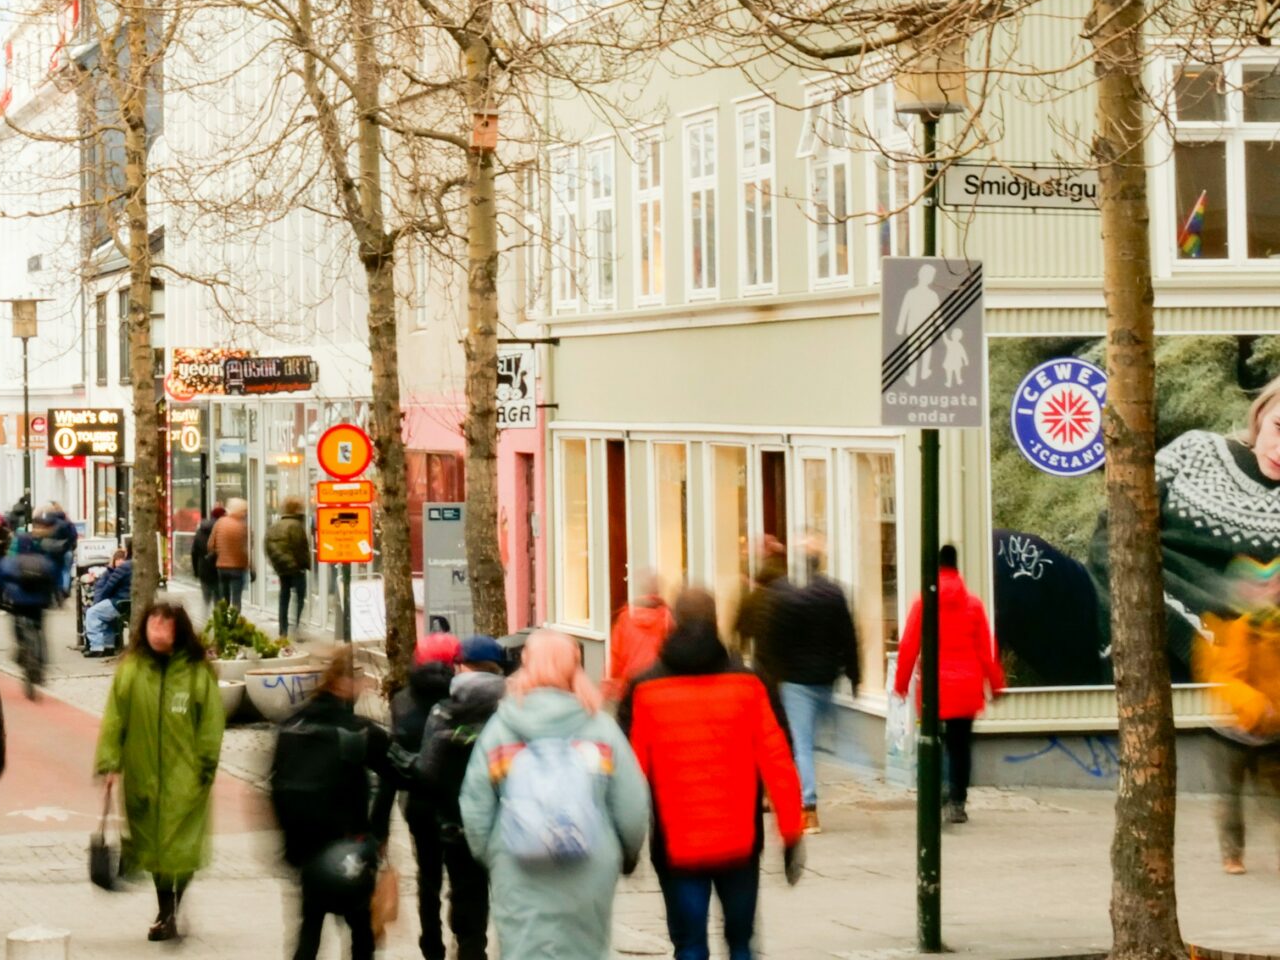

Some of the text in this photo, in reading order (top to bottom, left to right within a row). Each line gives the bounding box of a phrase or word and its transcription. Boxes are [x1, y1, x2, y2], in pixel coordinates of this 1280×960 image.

[963, 173, 1097, 202] Smiðjustigu
[178, 361, 224, 379] yeom
[1017, 362, 1107, 416] ICEWEA
[885, 391, 978, 409] Göngugata
[54, 410, 118, 424] What's On
[495, 405, 531, 423] AGA
[907, 409, 957, 423] endar
[76, 431, 117, 442] TOURIST
[92, 441, 117, 453] INFO
